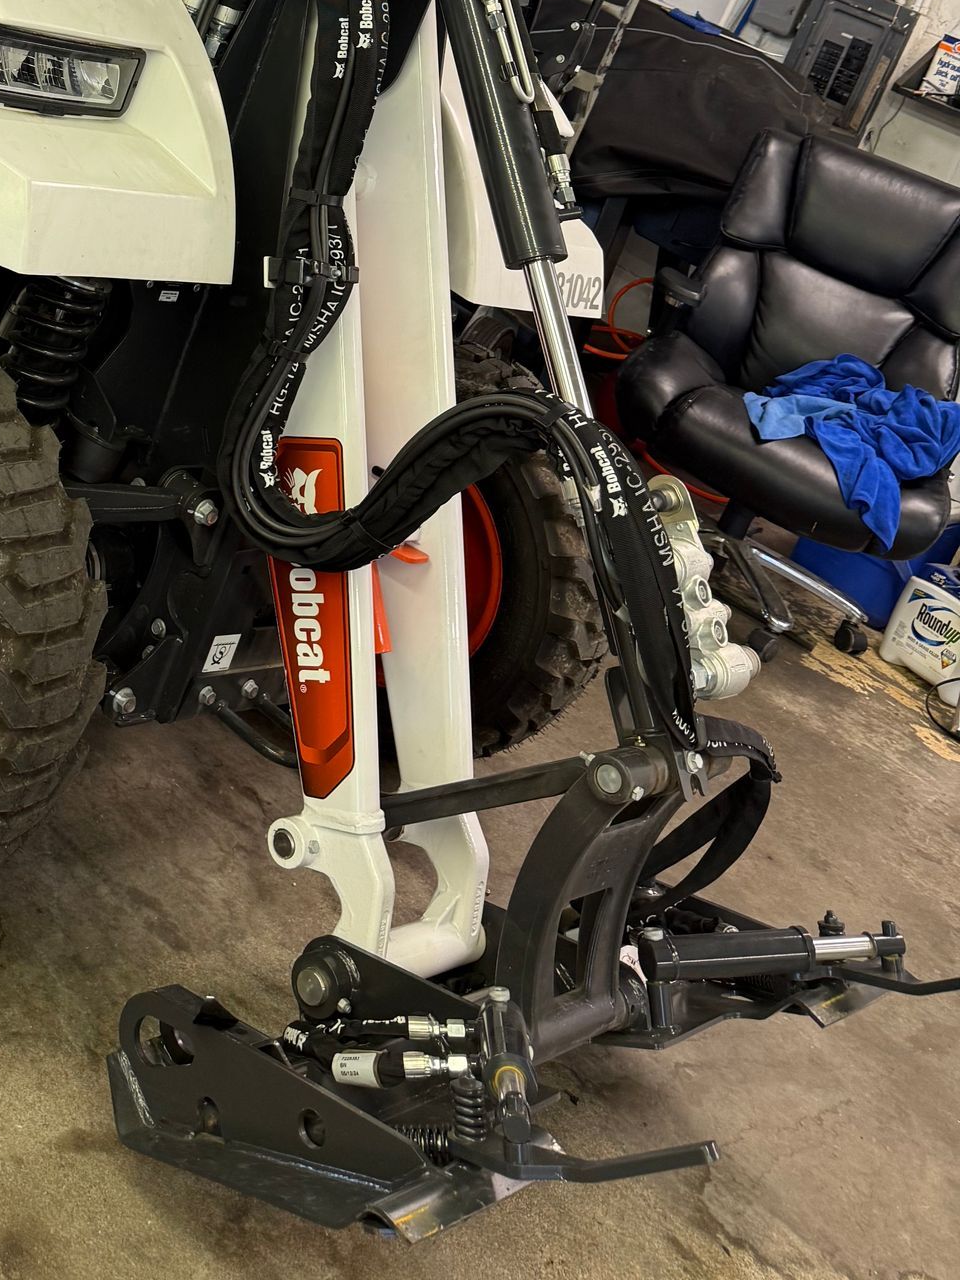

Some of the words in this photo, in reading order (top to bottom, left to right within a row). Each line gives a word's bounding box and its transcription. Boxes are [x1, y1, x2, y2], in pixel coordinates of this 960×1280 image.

[337, 17, 350, 59] Bobcat
[303, 300, 340, 349] MSHA
[260, 429, 274, 471] Bobcat
[590, 443, 622, 494] Bobcat
[642, 498, 675, 567] MSHA
[289, 562, 331, 684] obcat
[916, 602, 960, 646] Roundup
